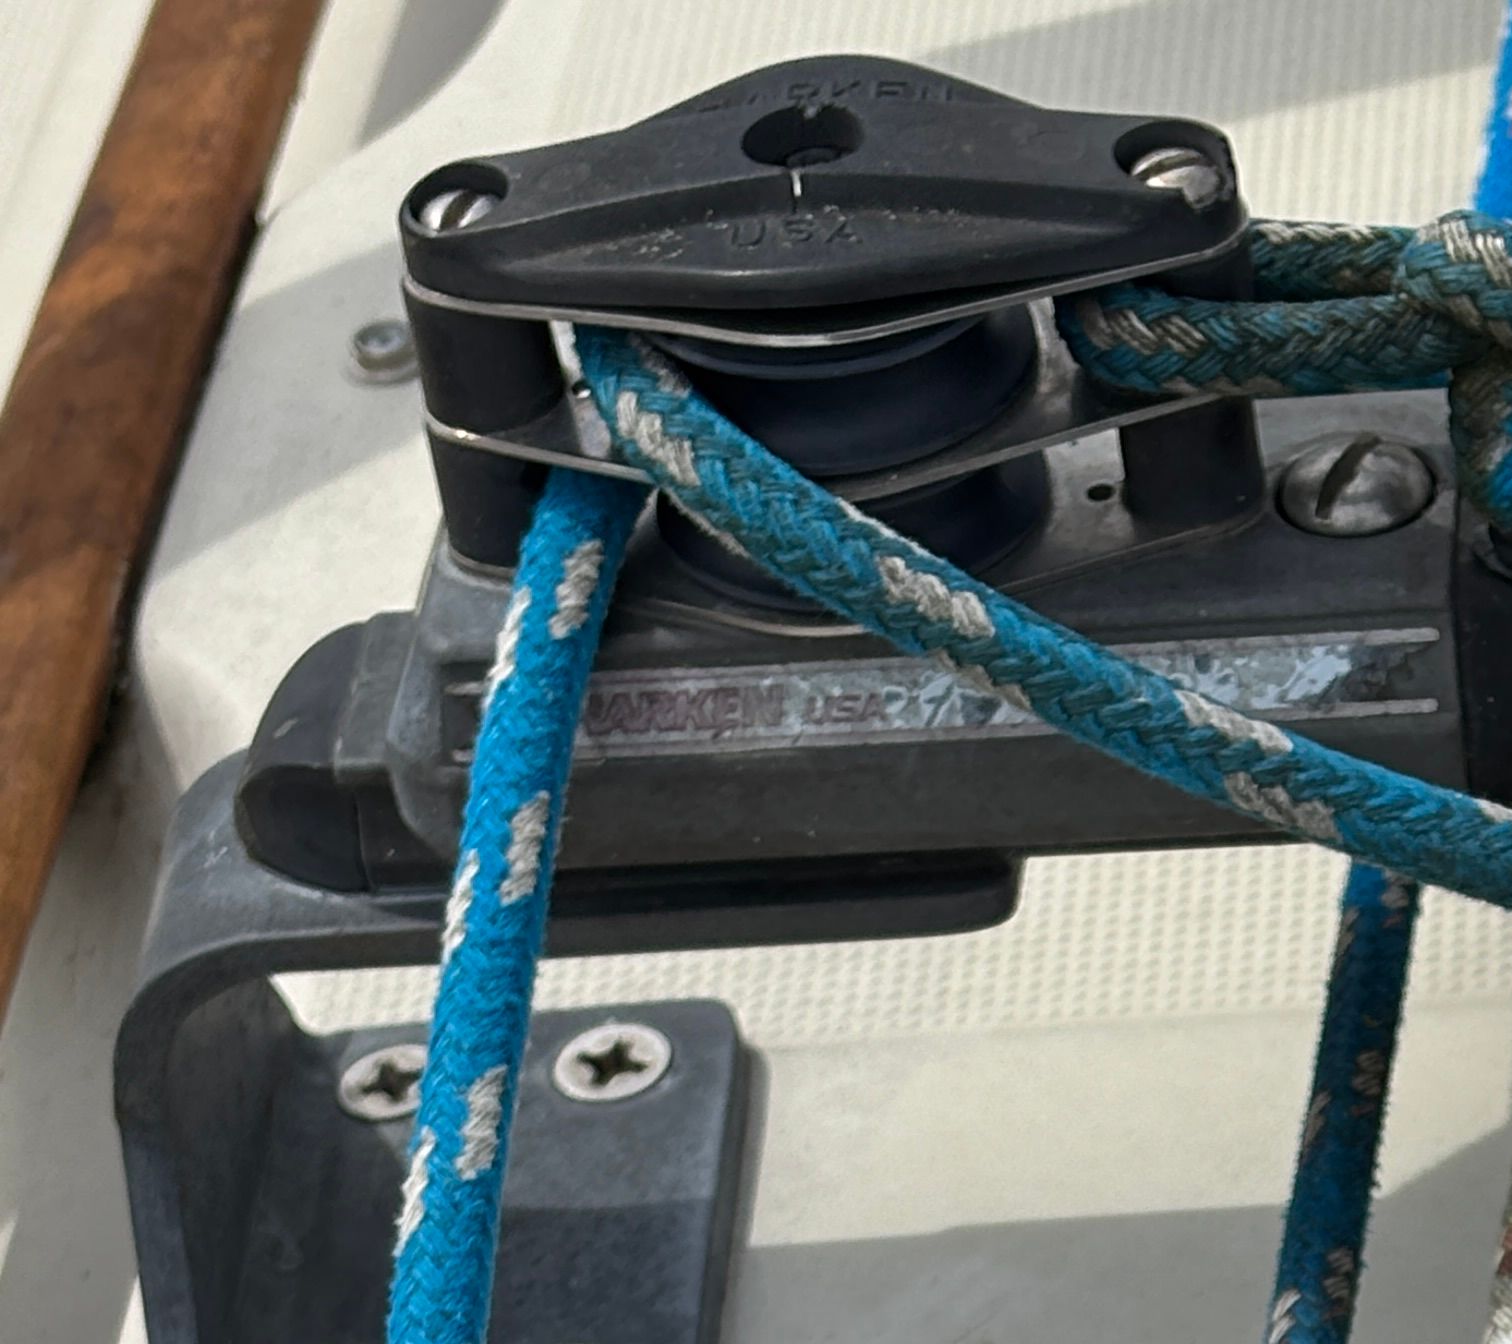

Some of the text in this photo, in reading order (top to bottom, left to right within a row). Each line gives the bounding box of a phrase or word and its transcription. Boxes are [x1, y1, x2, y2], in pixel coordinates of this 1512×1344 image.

[698, 80, 955, 113] RKEN
[731, 217, 863, 248] USA
[804, 692, 888, 725] USA
